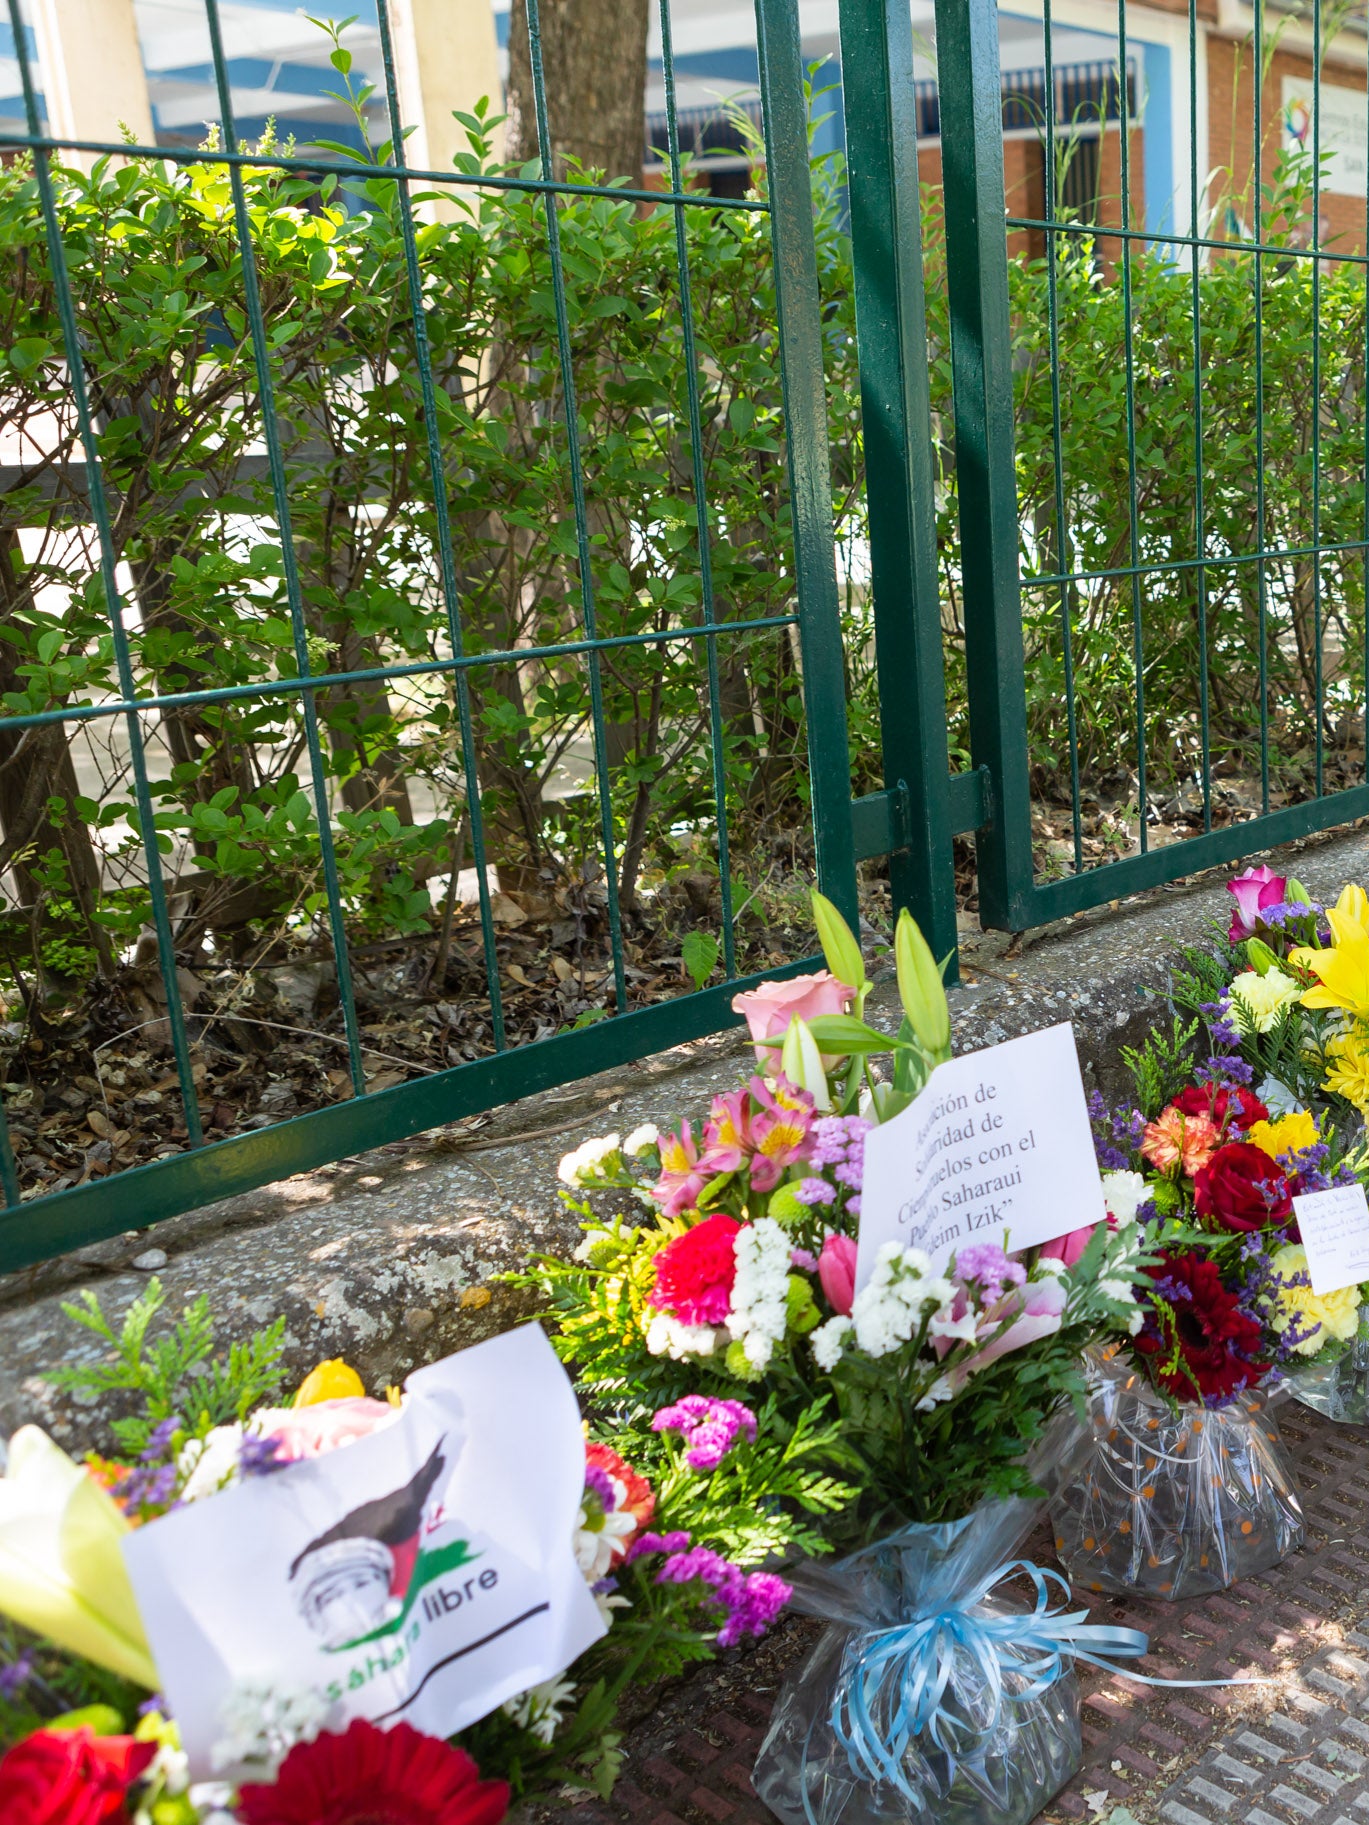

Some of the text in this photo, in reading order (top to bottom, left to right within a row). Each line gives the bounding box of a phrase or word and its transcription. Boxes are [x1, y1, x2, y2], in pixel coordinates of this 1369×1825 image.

[915, 1112, 1004, 1181] Sridad de
[916, 1083, 997, 1150] Asoación de
[898, 1130, 1036, 1224] Cieuelos con el
[941, 1164, 1022, 1212] Saharaui
[422, 1568, 498, 1623] libre
